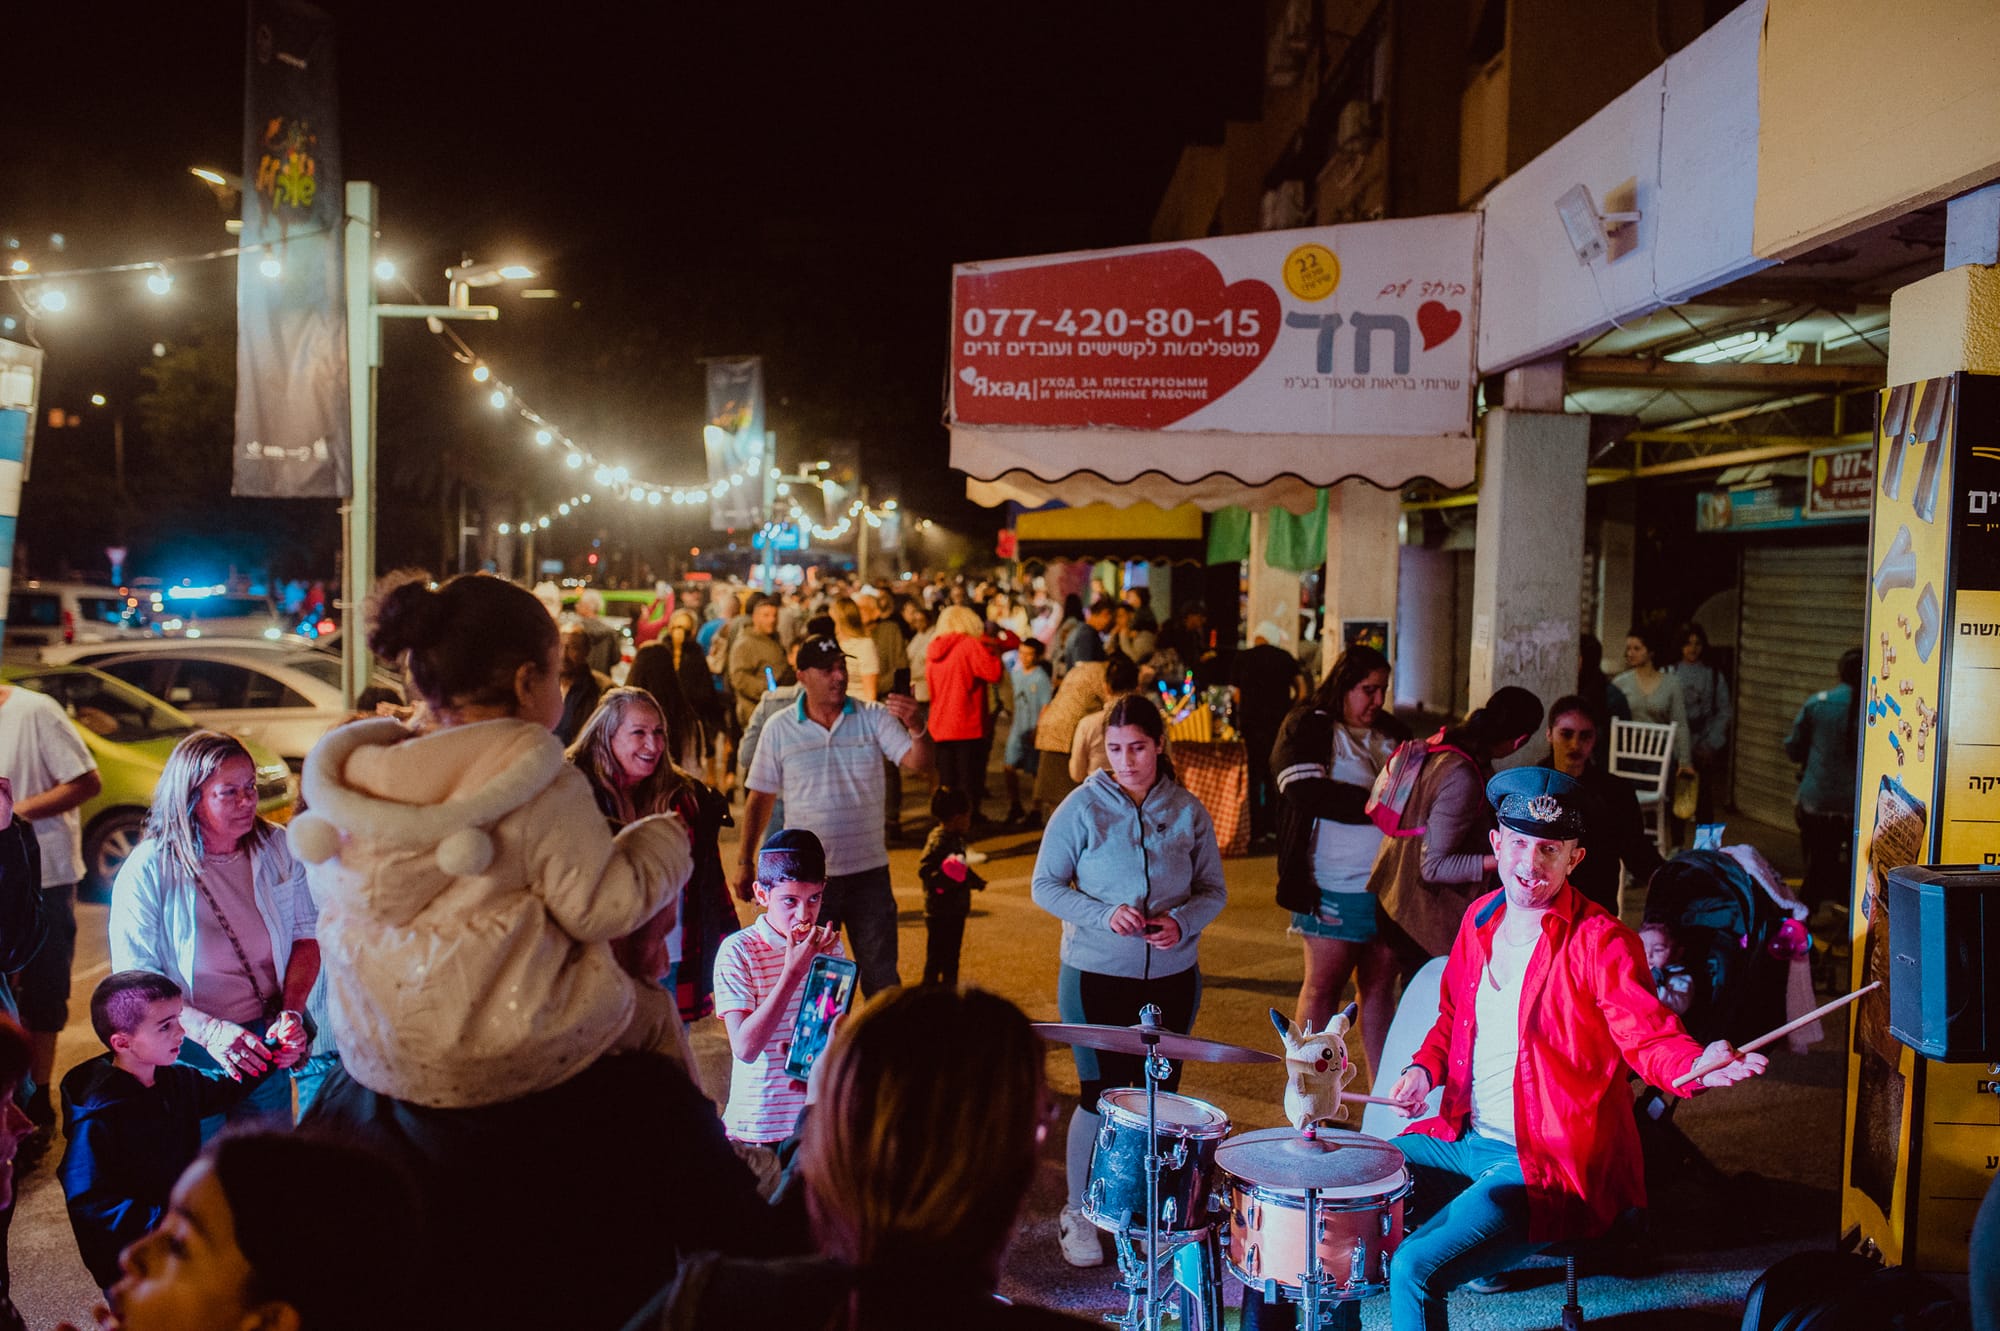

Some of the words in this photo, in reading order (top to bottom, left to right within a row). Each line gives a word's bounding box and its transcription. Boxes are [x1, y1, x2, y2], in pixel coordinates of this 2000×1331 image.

[1295, 253, 1317, 273] 22
[1420, 280, 1467, 298] ביחד
[962, 307, 1261, 338] 077-420-80-15
[962, 341, 1000, 357] זרים
[1006, 341, 1073, 357] ועובדים
[1077, 338, 1157, 360] לקשישים
[1161, 338, 1260, 357] מטפלים/ות
[972, 376, 1031, 400] Яхад
[1040, 378, 1076, 389] УХОД
[1081, 378, 1097, 388] ЗА
[1370, 378, 1417, 390] בריאות
[1420, 378, 1461, 390] שרותי
[1040, 389, 1050, 399] И
[1054, 389, 1148, 400] ИНОСТРАННЫЕ
[1151, 389, 1209, 400] РАБОЧИЕ
[1967, 490, 2000, 514] ים
